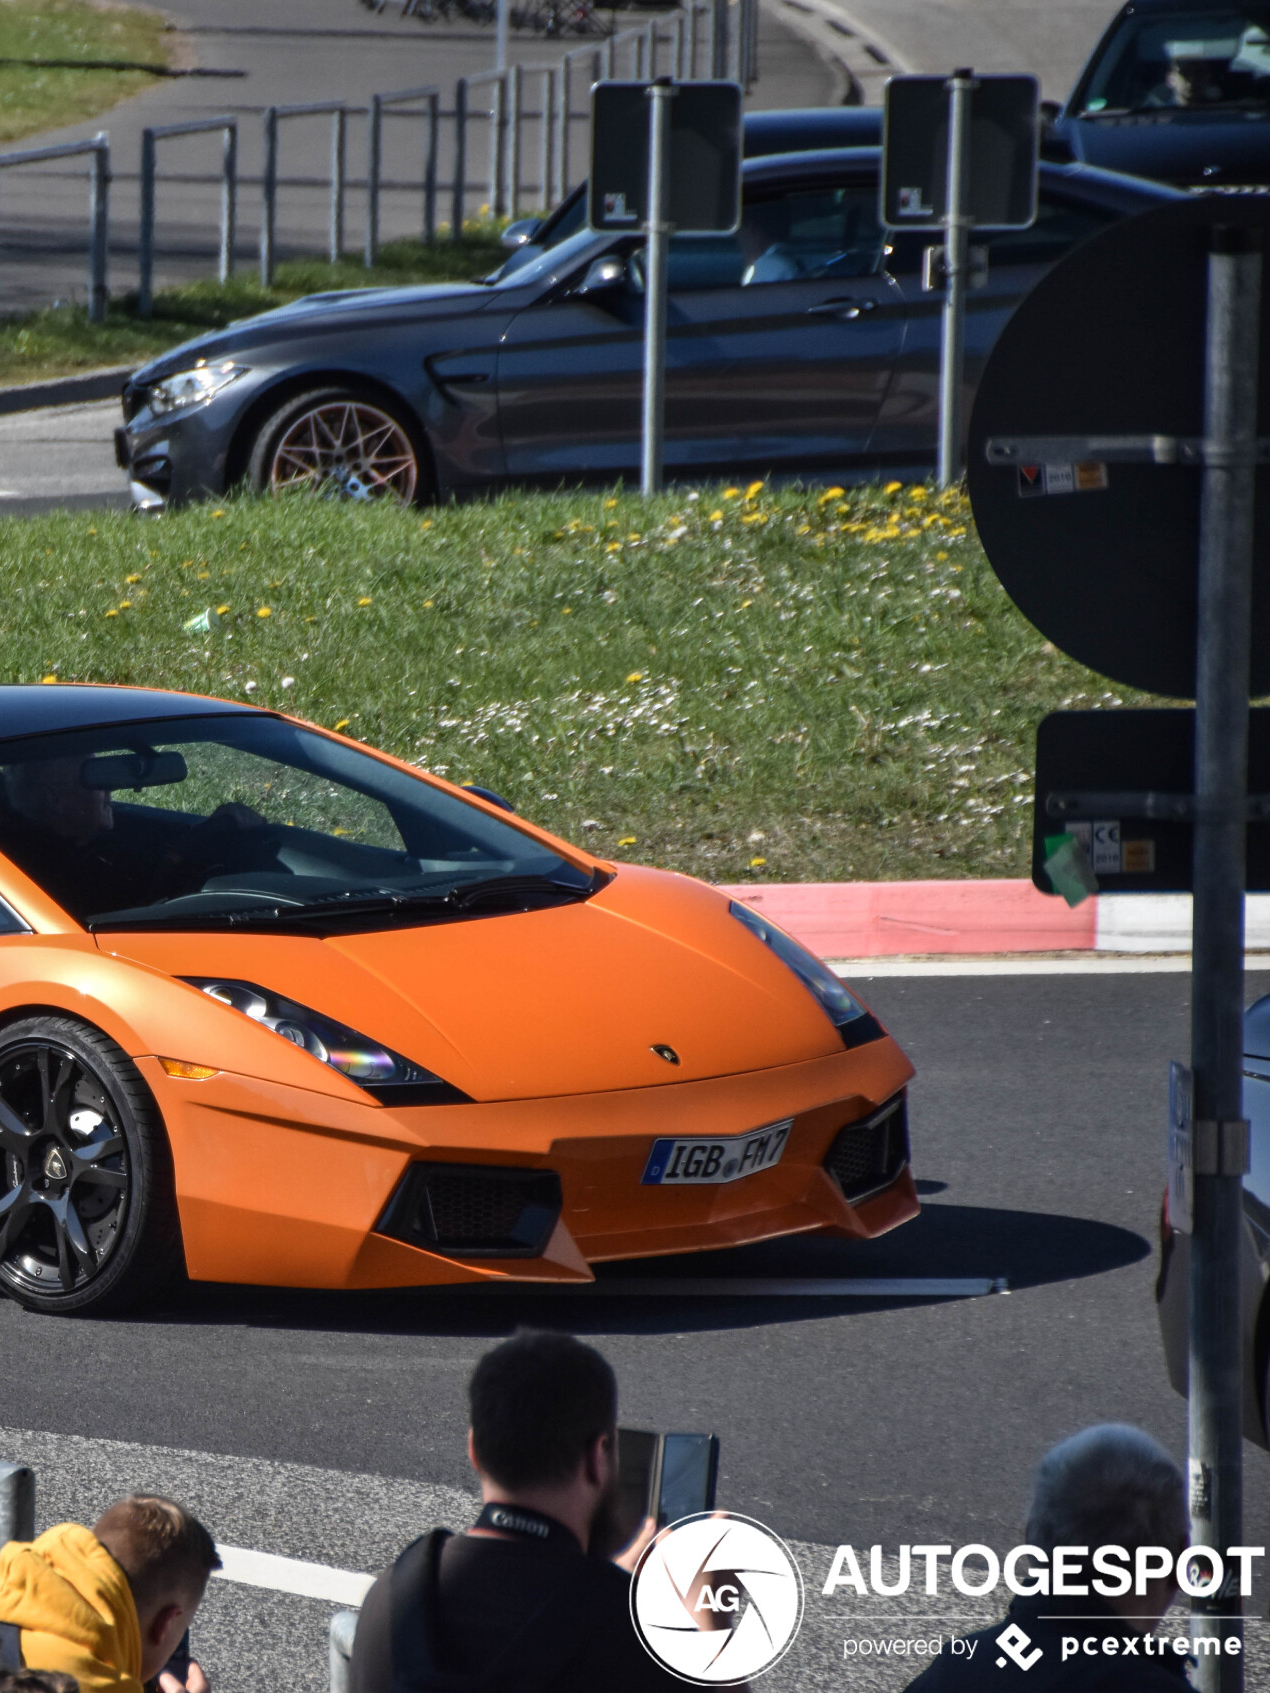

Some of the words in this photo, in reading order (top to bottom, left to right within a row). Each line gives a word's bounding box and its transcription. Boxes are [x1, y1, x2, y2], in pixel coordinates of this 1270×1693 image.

[665, 1145, 725, 1179] IGB
[738, 1133, 772, 1173] FM
[769, 1127, 789, 1162] 7
[491, 1510, 549, 1538] Canon
